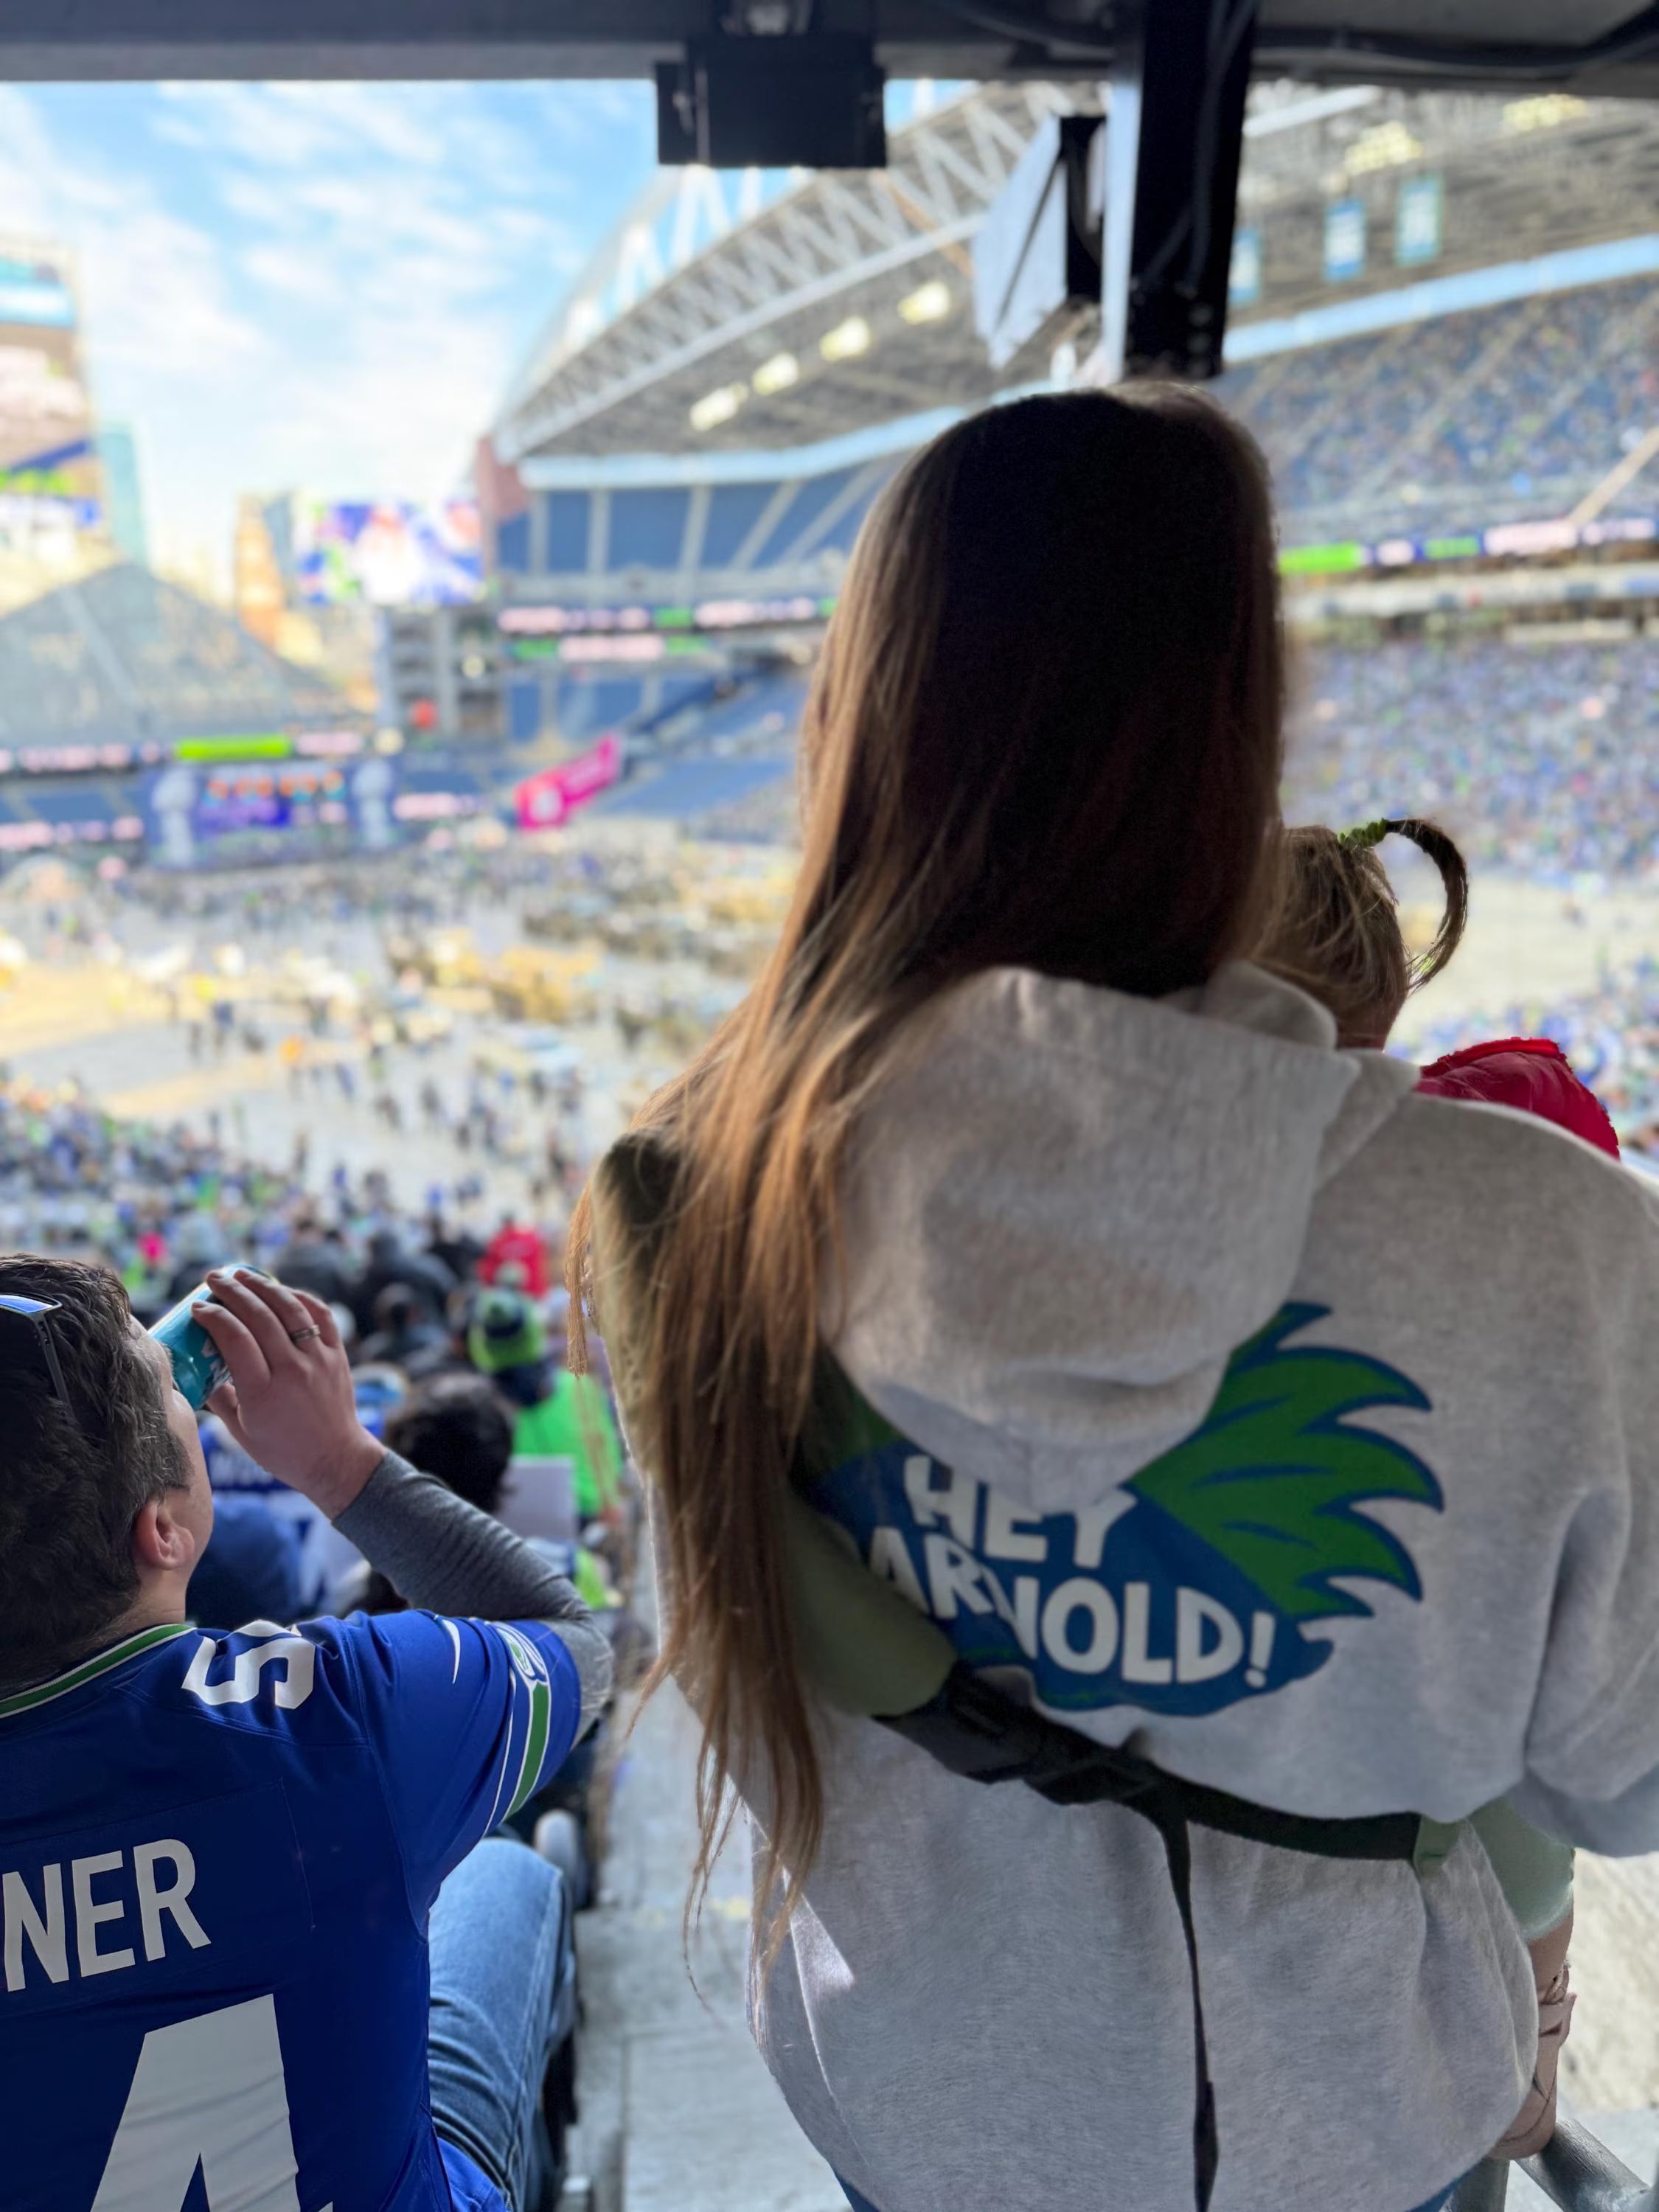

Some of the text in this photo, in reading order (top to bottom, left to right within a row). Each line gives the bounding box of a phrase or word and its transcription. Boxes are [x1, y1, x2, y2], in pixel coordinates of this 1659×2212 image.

[904, 1455, 1138, 1569] HEY
[870, 1527, 1276, 1688] ARNOLD!
[1, 1839, 212, 1992] NER
